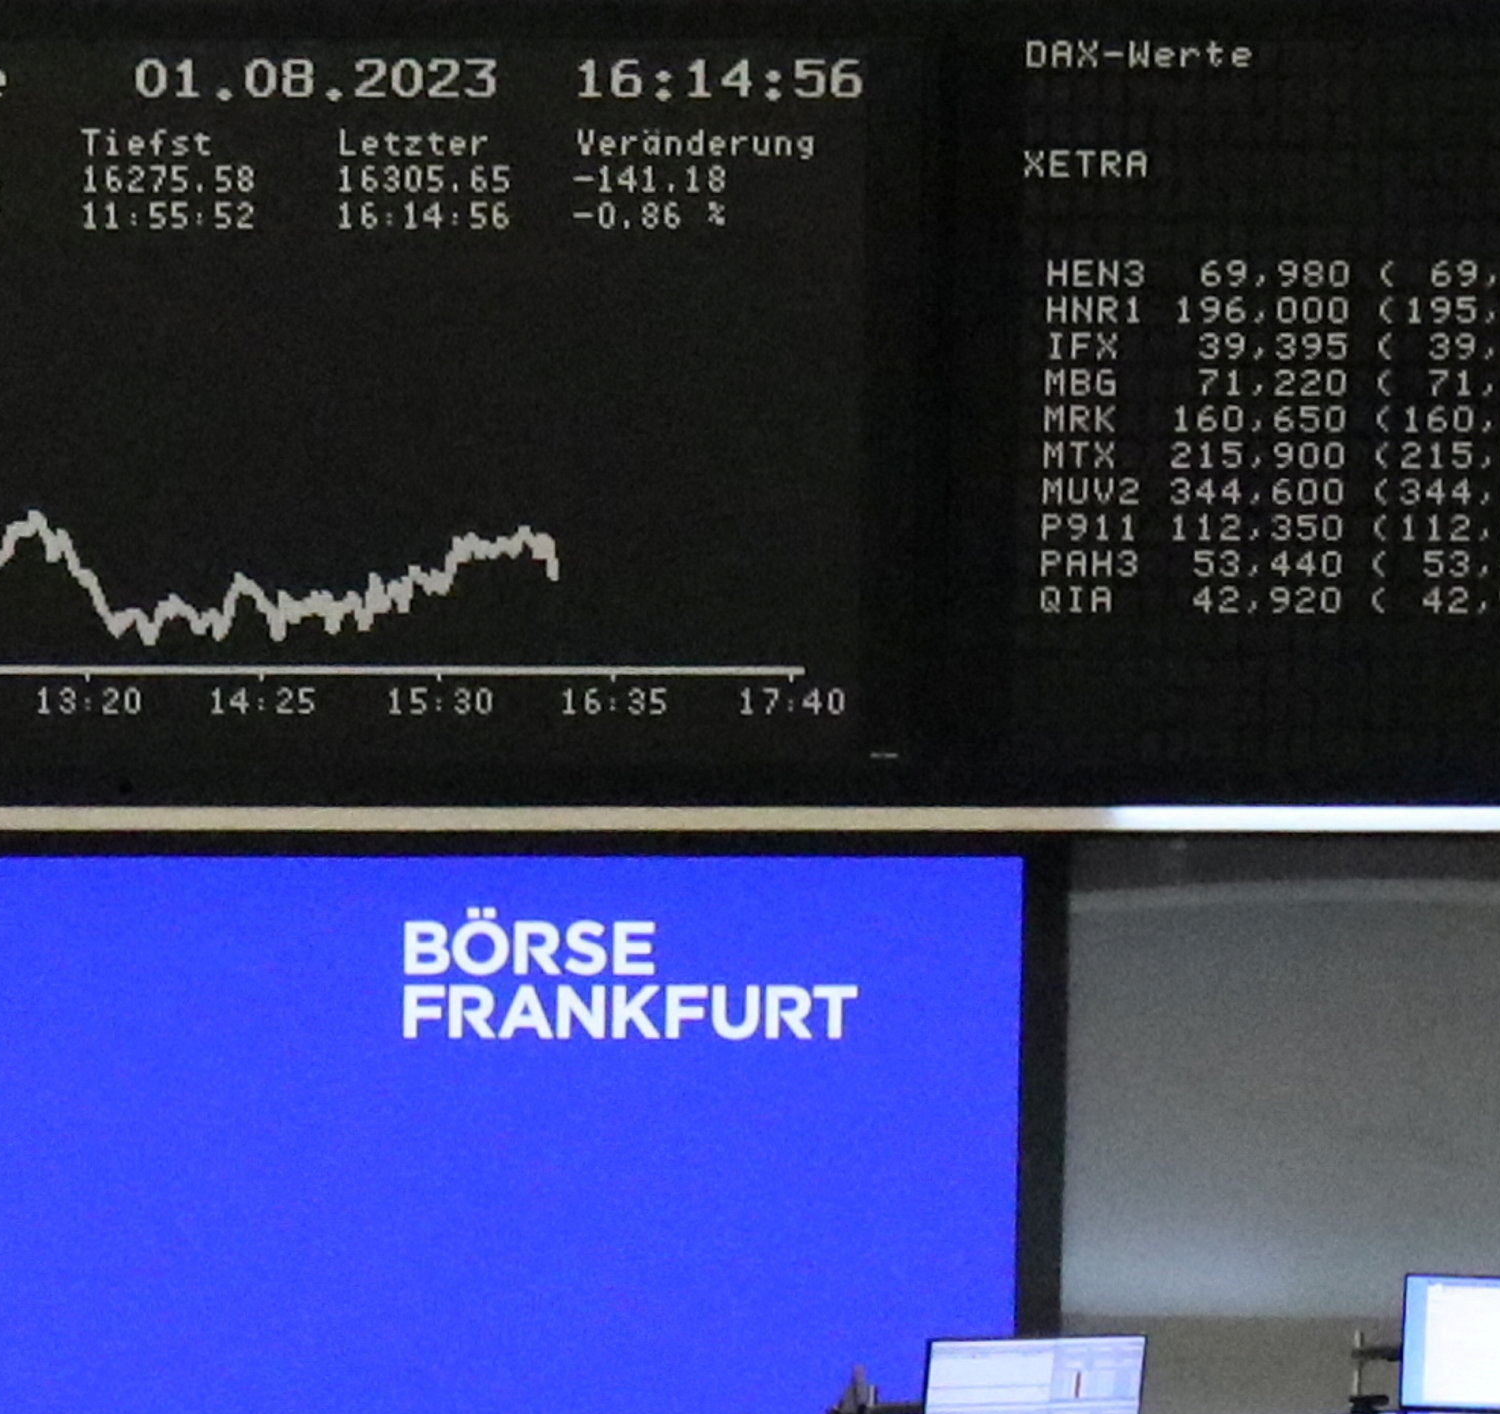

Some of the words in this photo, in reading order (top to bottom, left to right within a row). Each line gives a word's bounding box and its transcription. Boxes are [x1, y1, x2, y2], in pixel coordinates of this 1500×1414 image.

[1025, 39, 1252, 68] DAX-Werte
[135, 58, 497, 102] 01.08.2023
[579, 58, 863, 102] 16:14:56
[81, 127, 211, 157] Tiefst
[339, 128, 488, 157] Letzter
[577, 129, 814, 160] Veränderung
[1023, 149, 1148, 178] XETRA
[84, 164, 255, 193] 16275.58
[339, 164, 510, 193] 16305.65
[574, 164, 726, 193] -141.18
[83, 201, 255, 230] 11:55:52
[339, 201, 510, 230] 16:14:56
[573, 201, 681, 230] -0.86
[707, 202, 726, 229] %
[1046, 258, 1145, 288] HEN3
[1200, 259, 1350, 288] 69,980
[1045, 295, 1140, 324] HNR1
[1177, 295, 1349, 325] 196,000
[1049, 331, 1118, 361] IFX
[1199, 331, 1348, 361] 39,395
[1044, 368, 1117, 397] MBG
[1198, 367, 1347, 397] 71,220
[1043, 404, 1116, 433] MRK
[1174, 404, 1347, 433] 160,650
[1042, 440, 1115, 469] MTX
[1170, 440, 1345, 470] 215,900
[1041, 476, 1140, 506] MUV2
[1170, 476, 1344, 506] 344,600
[1041, 512, 1135, 542] P911
[1172, 513, 1344, 542] 112,350
[1040, 549, 1139, 578] PAH3
[1193, 549, 1343, 578] 53,440
[1039, 585, 1112, 614] QIA
[1192, 585, 1342, 614] 42,920
[38, 686, 141, 715] 13:20
[212, 686, 315, 715] 14:25
[389, 686, 493, 715] 15:30
[563, 687, 667, 715] 16:35
[741, 687, 845, 715] 17:40
[404, 907, 656, 976] BÖRSE
[403, 984, 858, 1040] FRANKFURT
